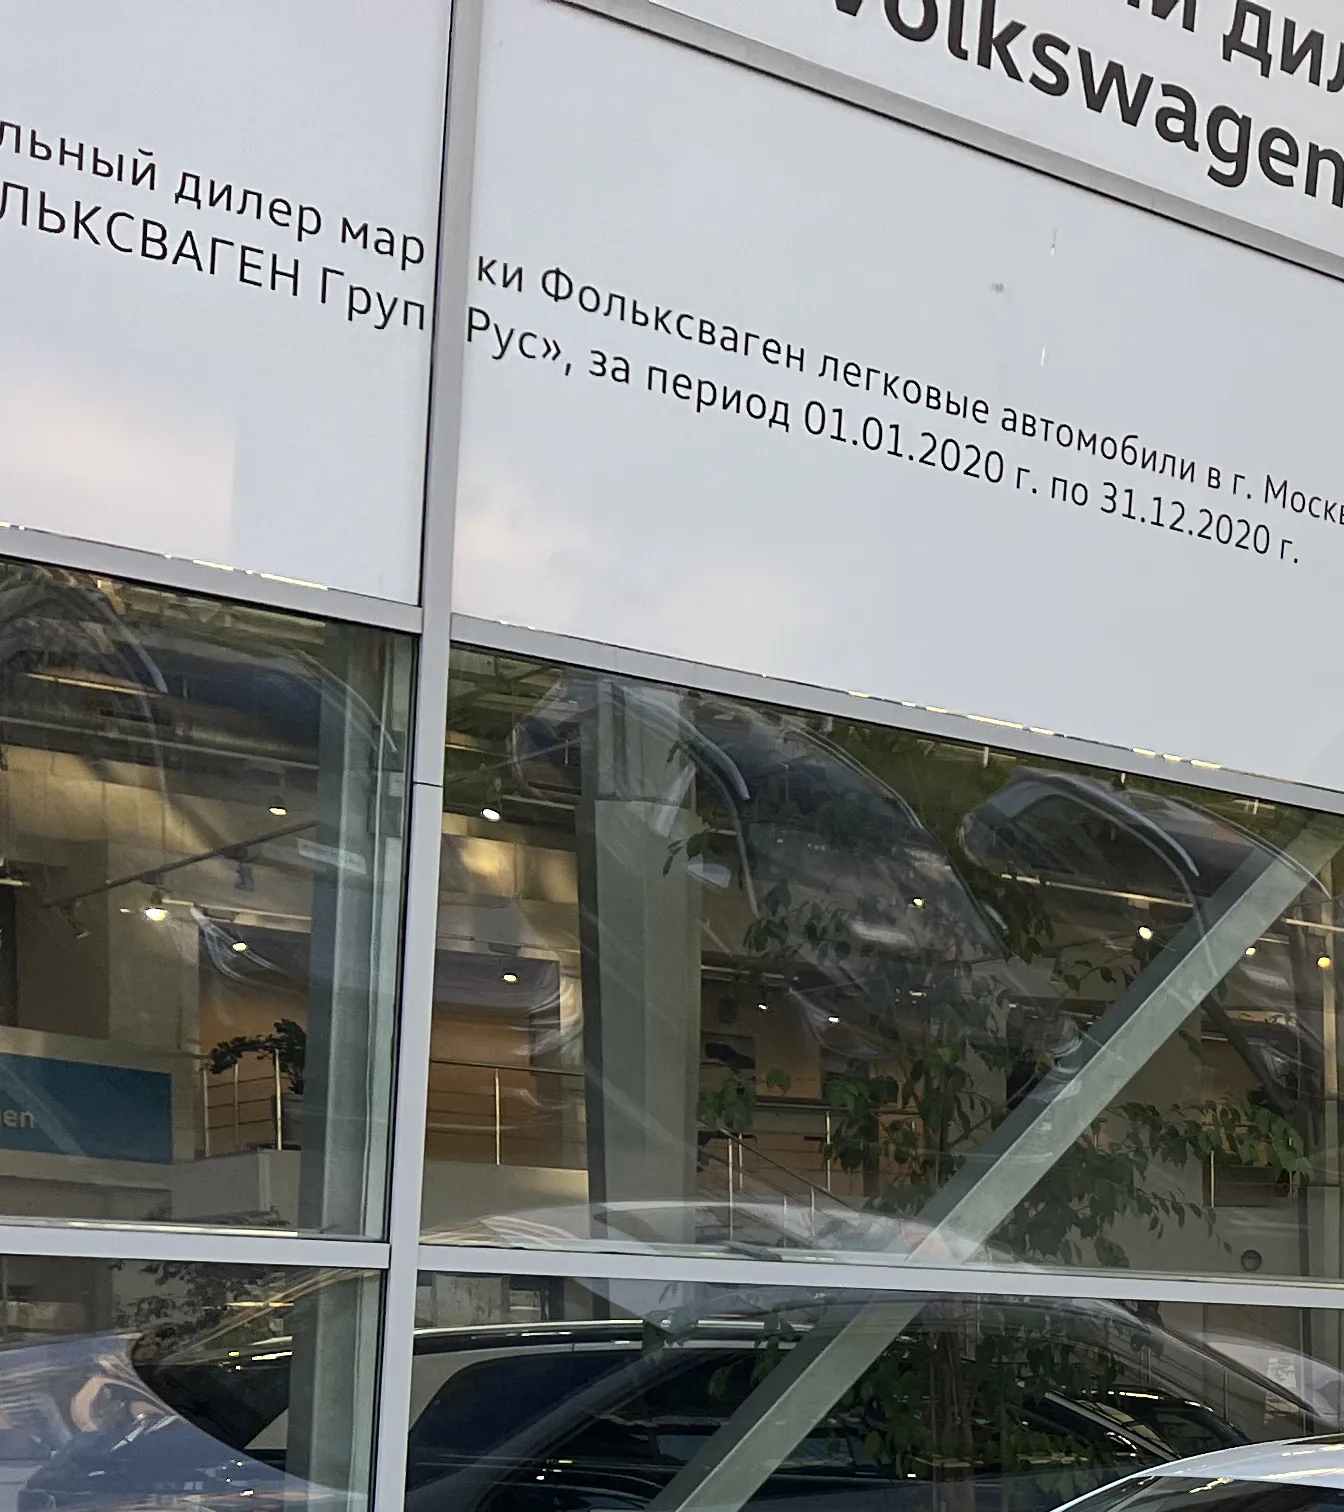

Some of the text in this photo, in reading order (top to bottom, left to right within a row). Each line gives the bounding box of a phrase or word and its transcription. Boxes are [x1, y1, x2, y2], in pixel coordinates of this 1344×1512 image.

[174, 171, 322, 243] дилер
[541, 267, 805, 372] Фольксваген
[818, 354, 989, 424] легковые
[1001, 407, 1195, 483] автомобили
[1207, 466, 1221, 490] в
[1232, 473, 1251, 500] г.
[320, 266, 425, 331] Груп
[466, 306, 572, 377] Рус»,
[588, 350, 630, 384] за
[647, 365, 790, 433] период
[804, 400, 1004, 484] 01.01.2020
[1016, 467, 1039, 496] г.
[1051, 476, 1088, 506] по
[1100, 481, 1270, 555] 31.12.2020
[1280, 538, 1299, 564] г.
